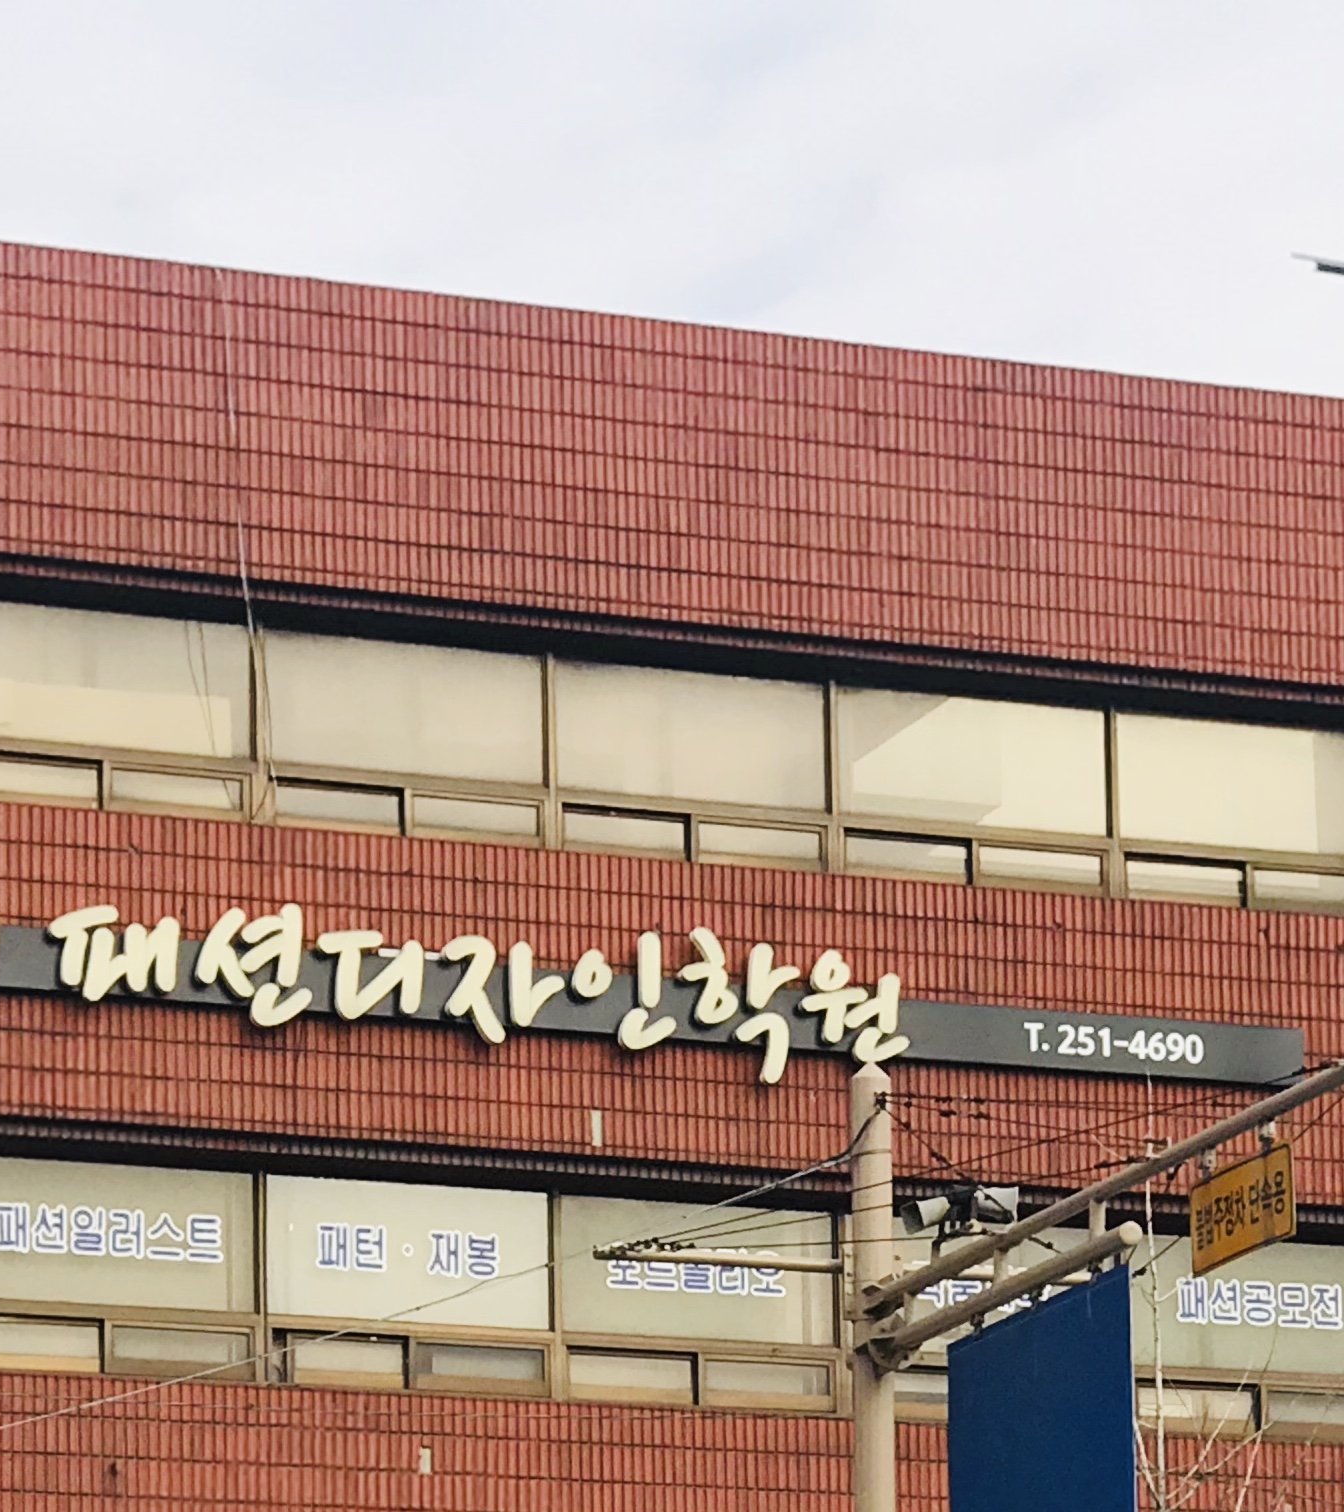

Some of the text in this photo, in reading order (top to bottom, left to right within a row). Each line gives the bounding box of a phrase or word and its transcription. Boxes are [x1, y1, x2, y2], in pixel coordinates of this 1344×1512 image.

[316, 1221, 501, 1279] 패턴 재봉
[1176, 1277, 1344, 1330] 패션공모전
